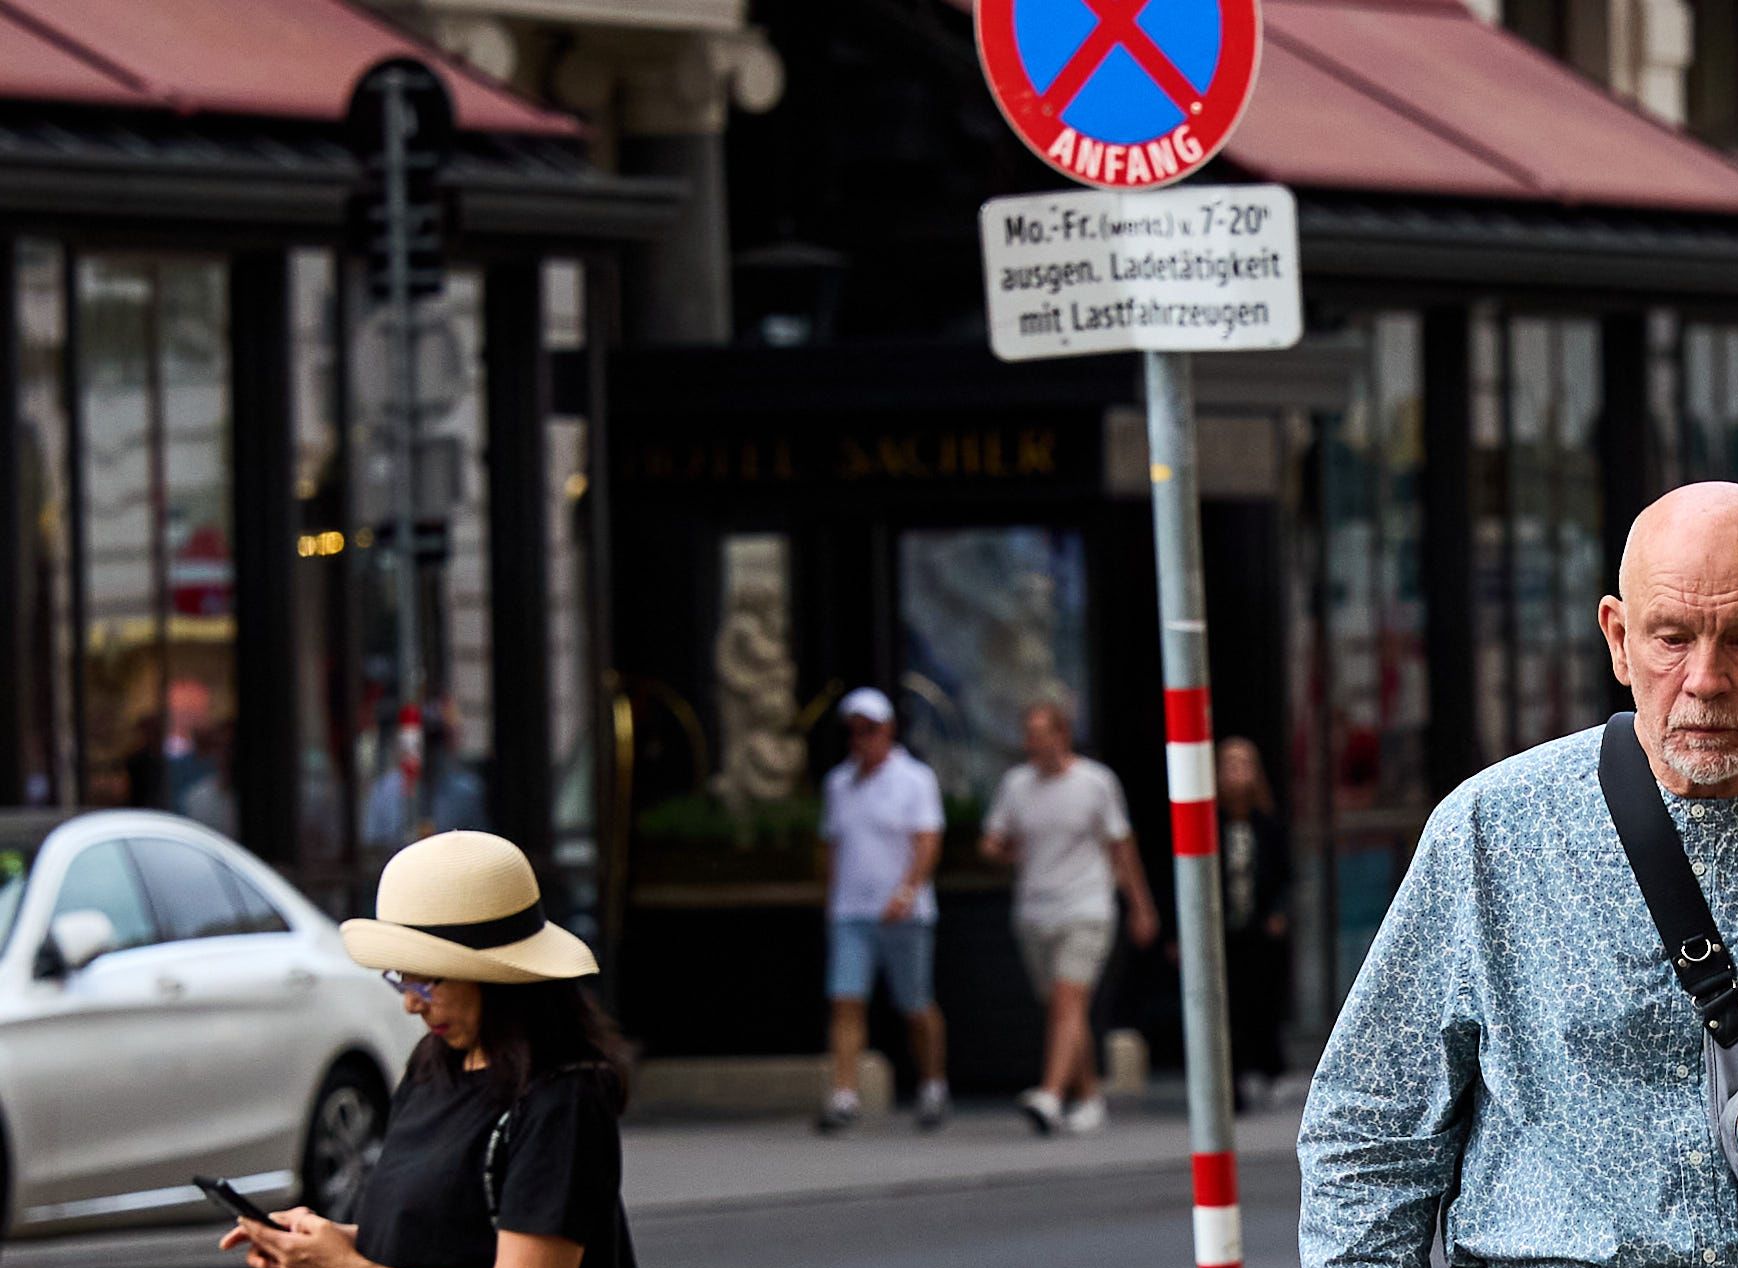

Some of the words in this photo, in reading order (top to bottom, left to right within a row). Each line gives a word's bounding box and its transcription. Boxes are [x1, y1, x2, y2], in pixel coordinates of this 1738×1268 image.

[1048, 124, 1203, 185] ANFANG
[1109, 247, 1281, 287] Ladetätigkeit
[1018, 302, 1063, 335] mit
[1070, 297, 1270, 335] Lastfahrzeugen
